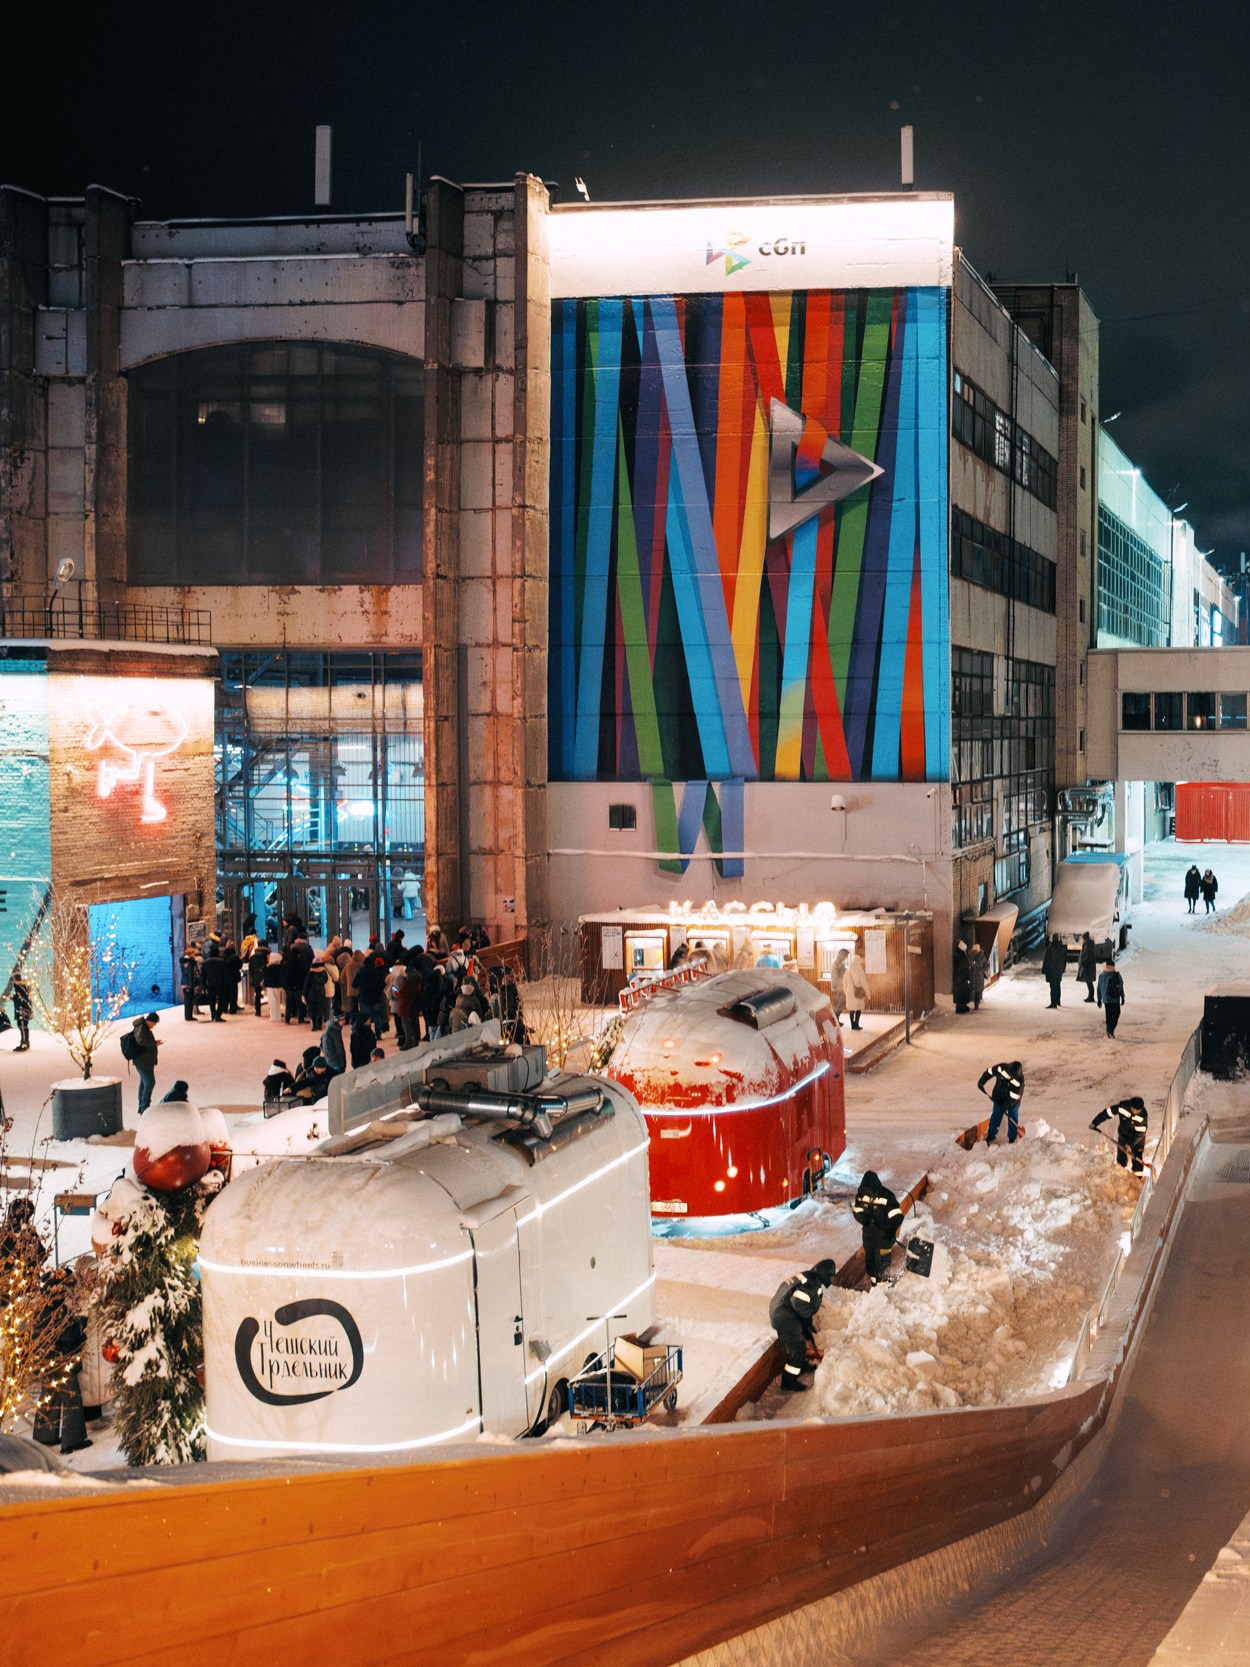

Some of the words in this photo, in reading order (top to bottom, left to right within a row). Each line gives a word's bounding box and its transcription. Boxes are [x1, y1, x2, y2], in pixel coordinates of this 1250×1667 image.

[758, 237, 806, 256] сбп
[263, 1319, 339, 1357] Чешский
[257, 1341, 348, 1390] Трдельник
